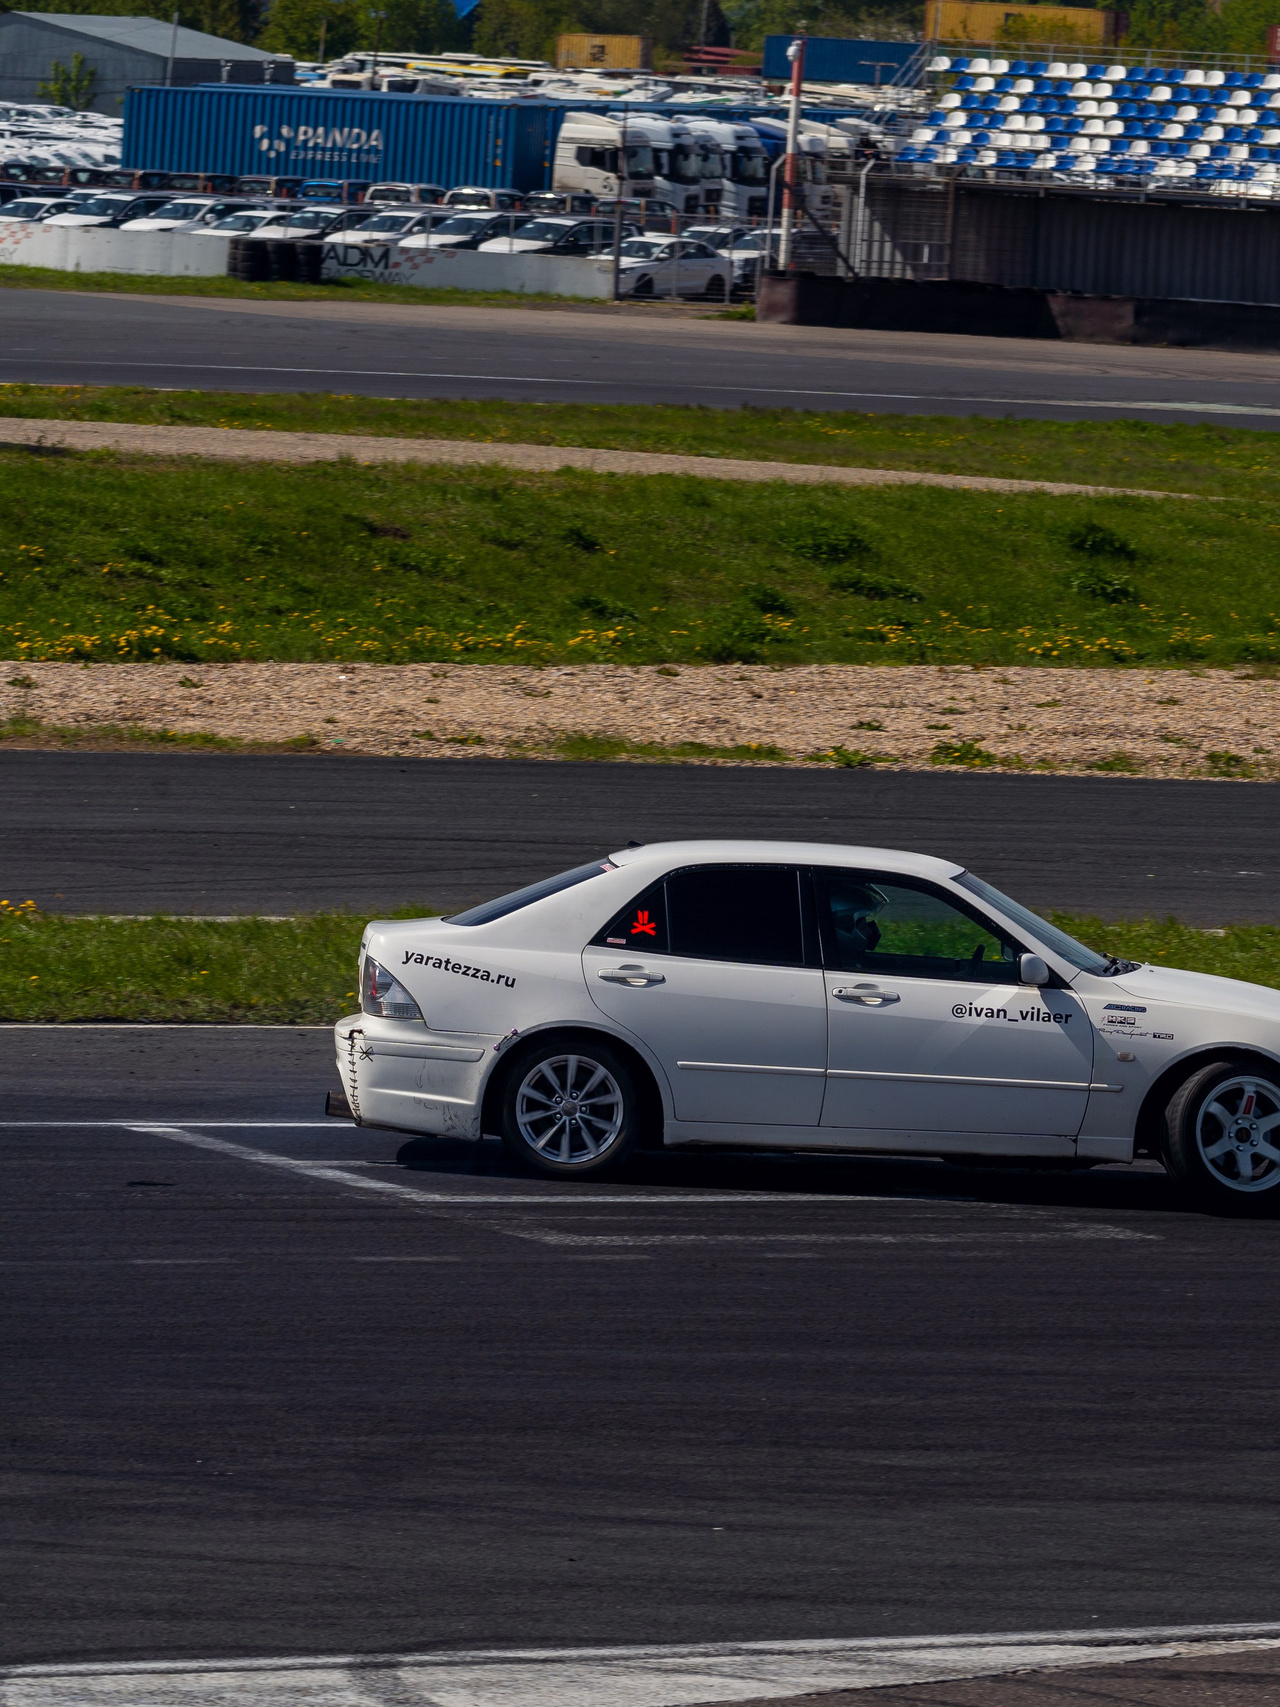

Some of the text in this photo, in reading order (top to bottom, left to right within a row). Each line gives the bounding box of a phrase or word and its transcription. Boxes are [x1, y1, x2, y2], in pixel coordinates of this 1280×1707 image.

[295, 125, 383, 150] PANDA
[321, 244, 390, 270] ADM
[401, 950, 517, 988] yaratezza.ru
[951, 1002, 1072, 1024] @ivan_vilaer
